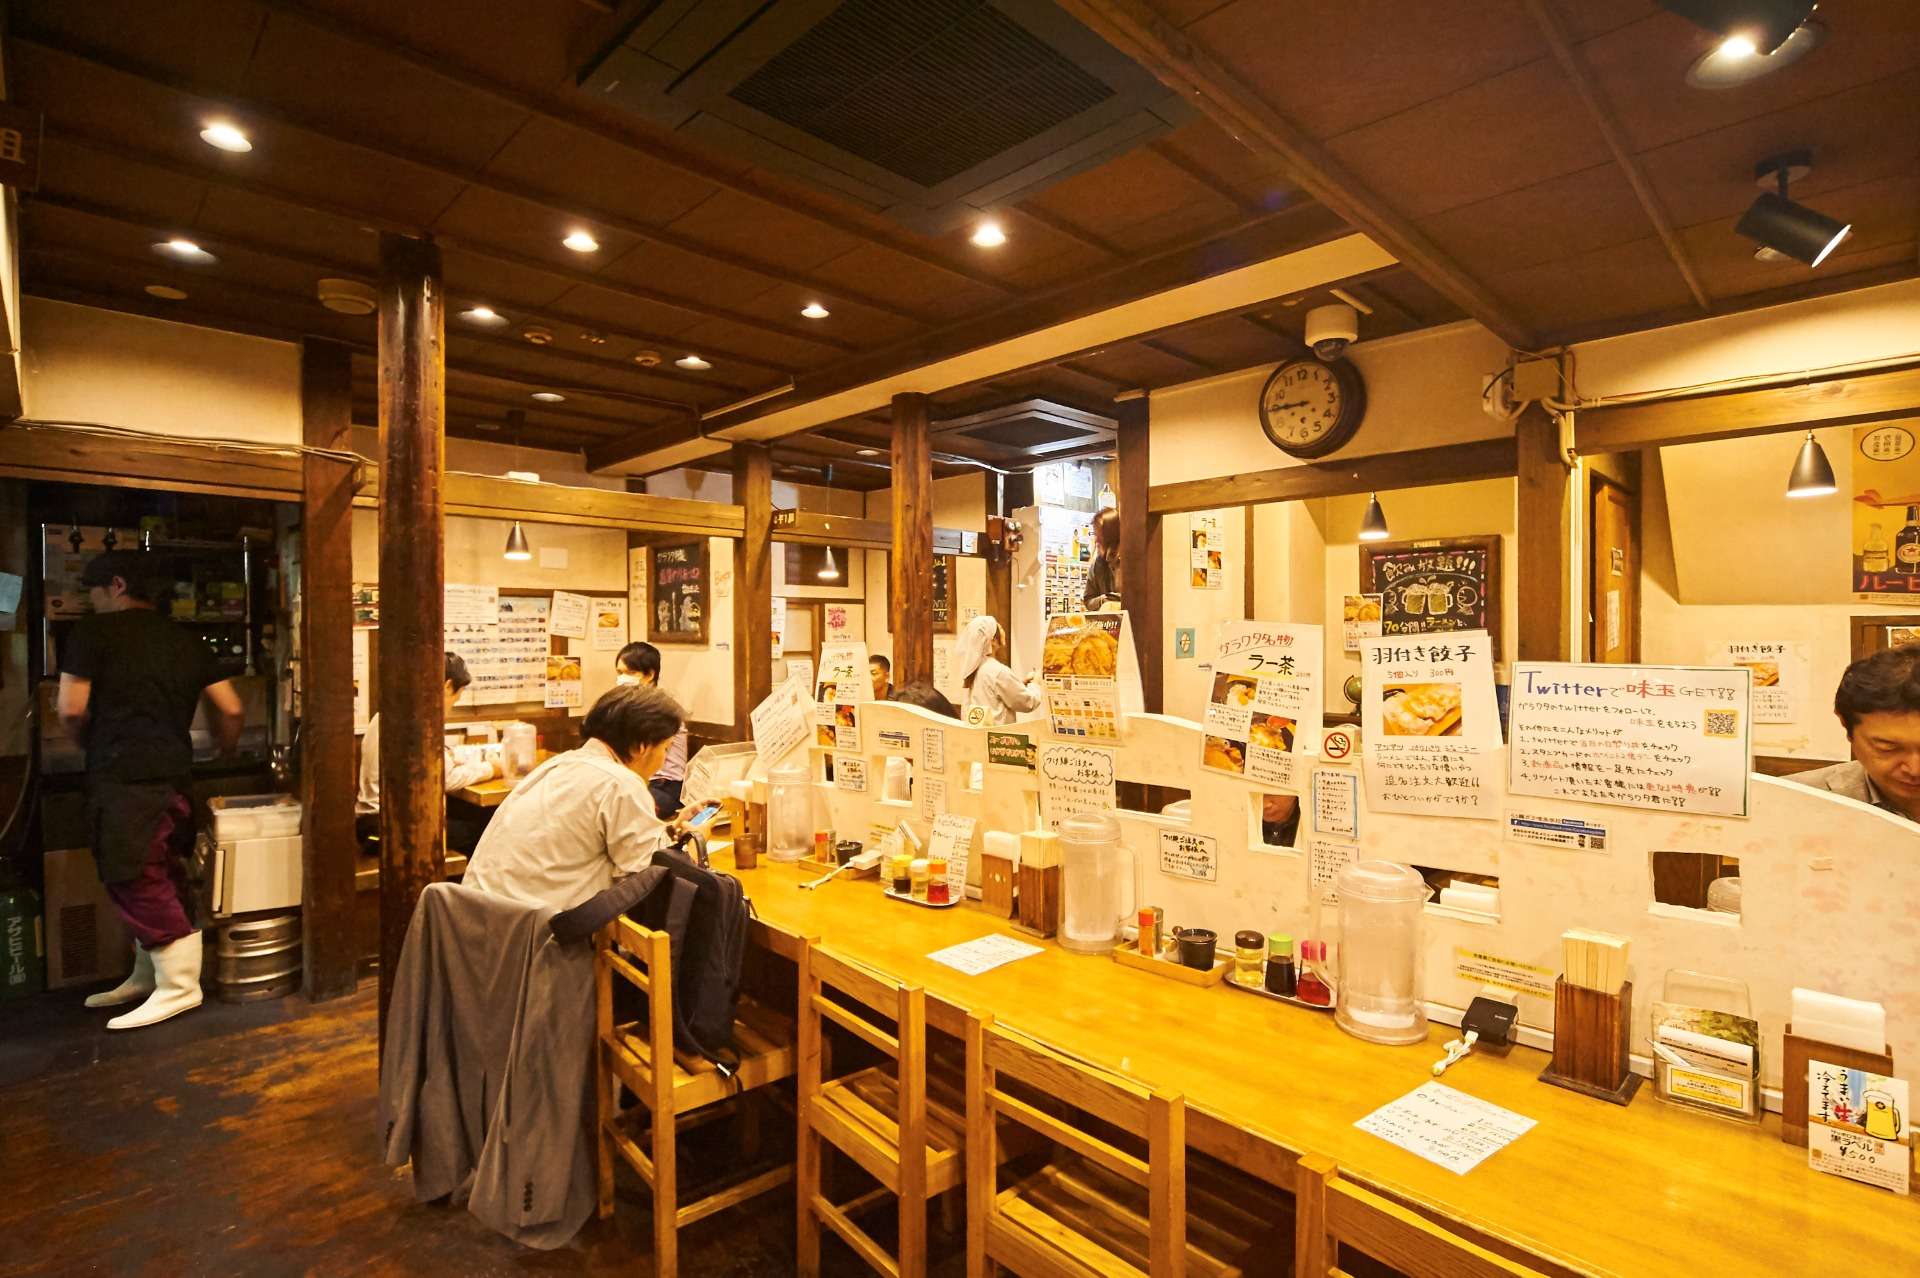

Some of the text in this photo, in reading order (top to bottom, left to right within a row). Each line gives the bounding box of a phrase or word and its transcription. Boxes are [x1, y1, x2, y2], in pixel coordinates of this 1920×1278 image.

[1248, 654, 1295, 676] ラー茶
[1371, 645, 1477, 665] 羽付き餃子
